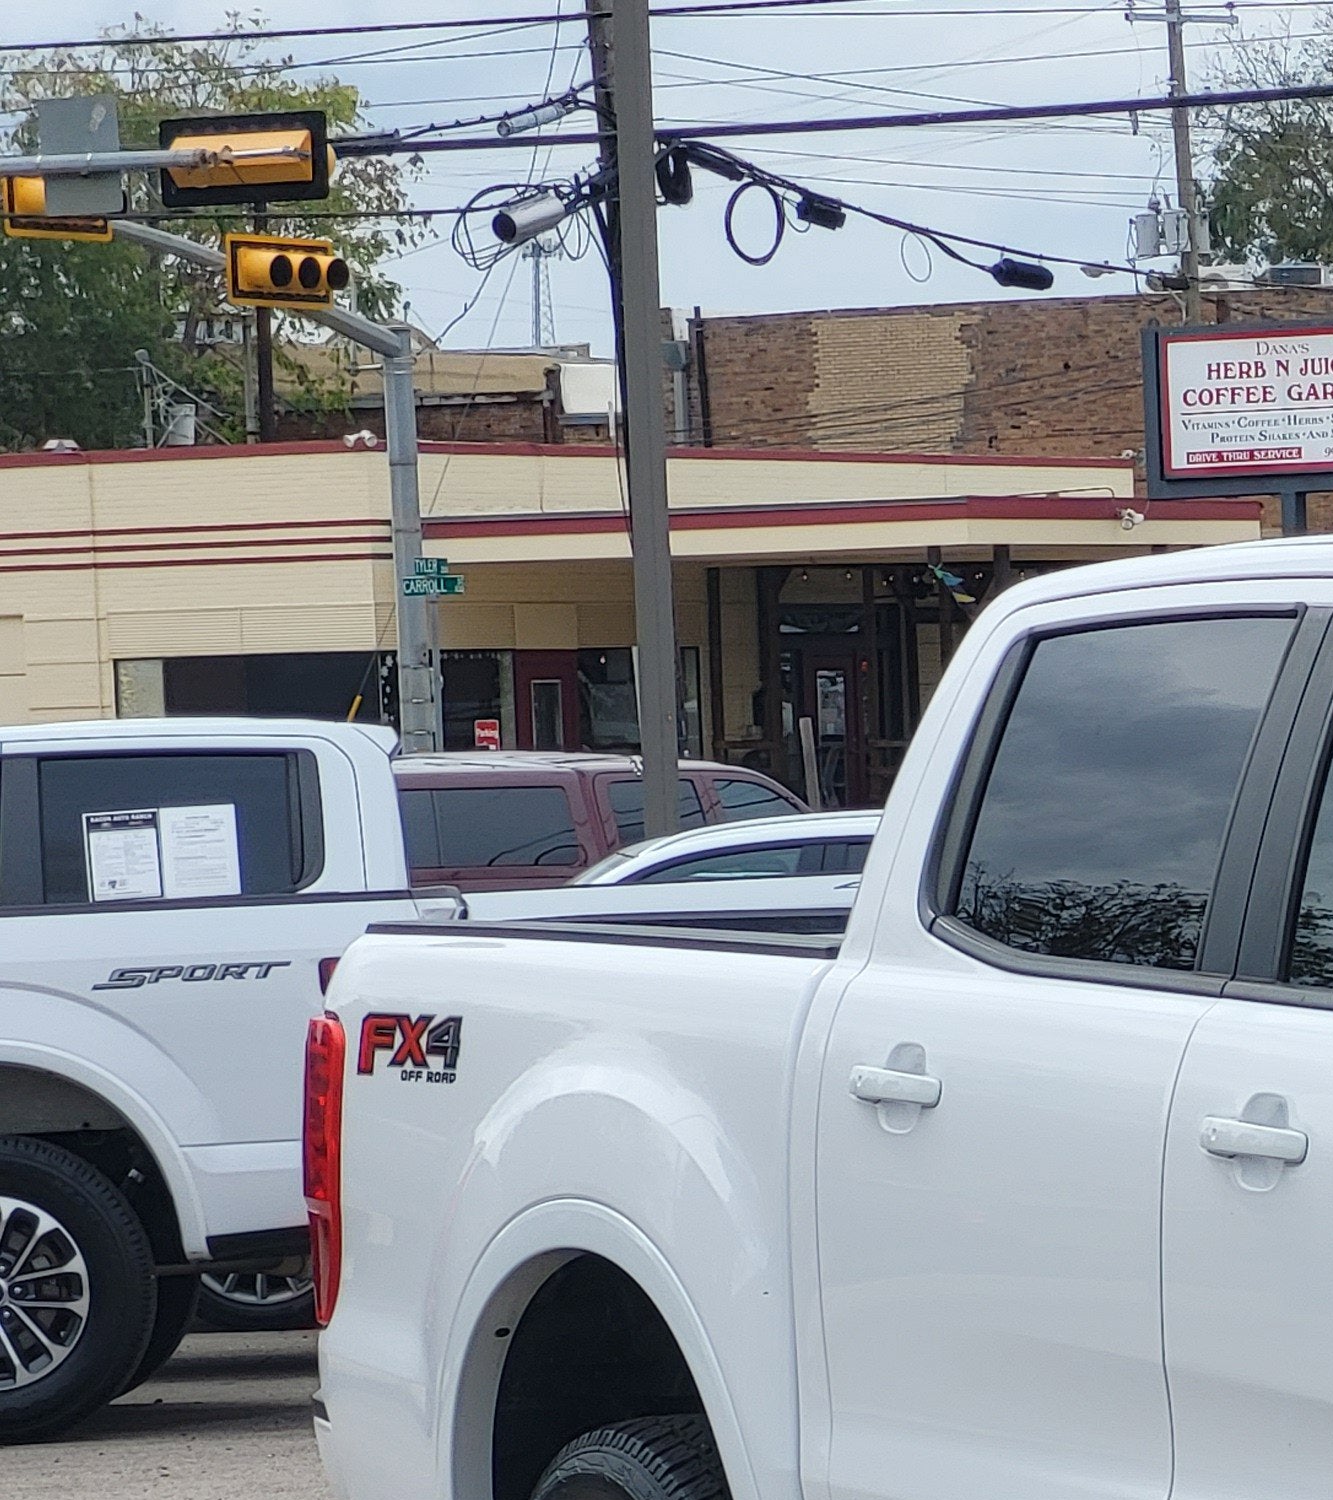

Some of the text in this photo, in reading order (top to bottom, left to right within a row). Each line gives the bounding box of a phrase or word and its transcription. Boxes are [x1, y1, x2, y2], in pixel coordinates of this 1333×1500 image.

[1207, 360, 1267, 381] HERB
[1275, 359, 1290, 377] N
[1182, 385, 1277, 407] COFFEE
[1188, 448, 1300, 463] DRIVE THRU SERVICE
[415, 559, 438, 573] TYLER
[403, 579, 447, 594] CARROLL
[91, 961, 291, 990] SPORT
[357, 1012, 462, 1075] FX4
[401, 1070, 456, 1083] OFF ROAD
